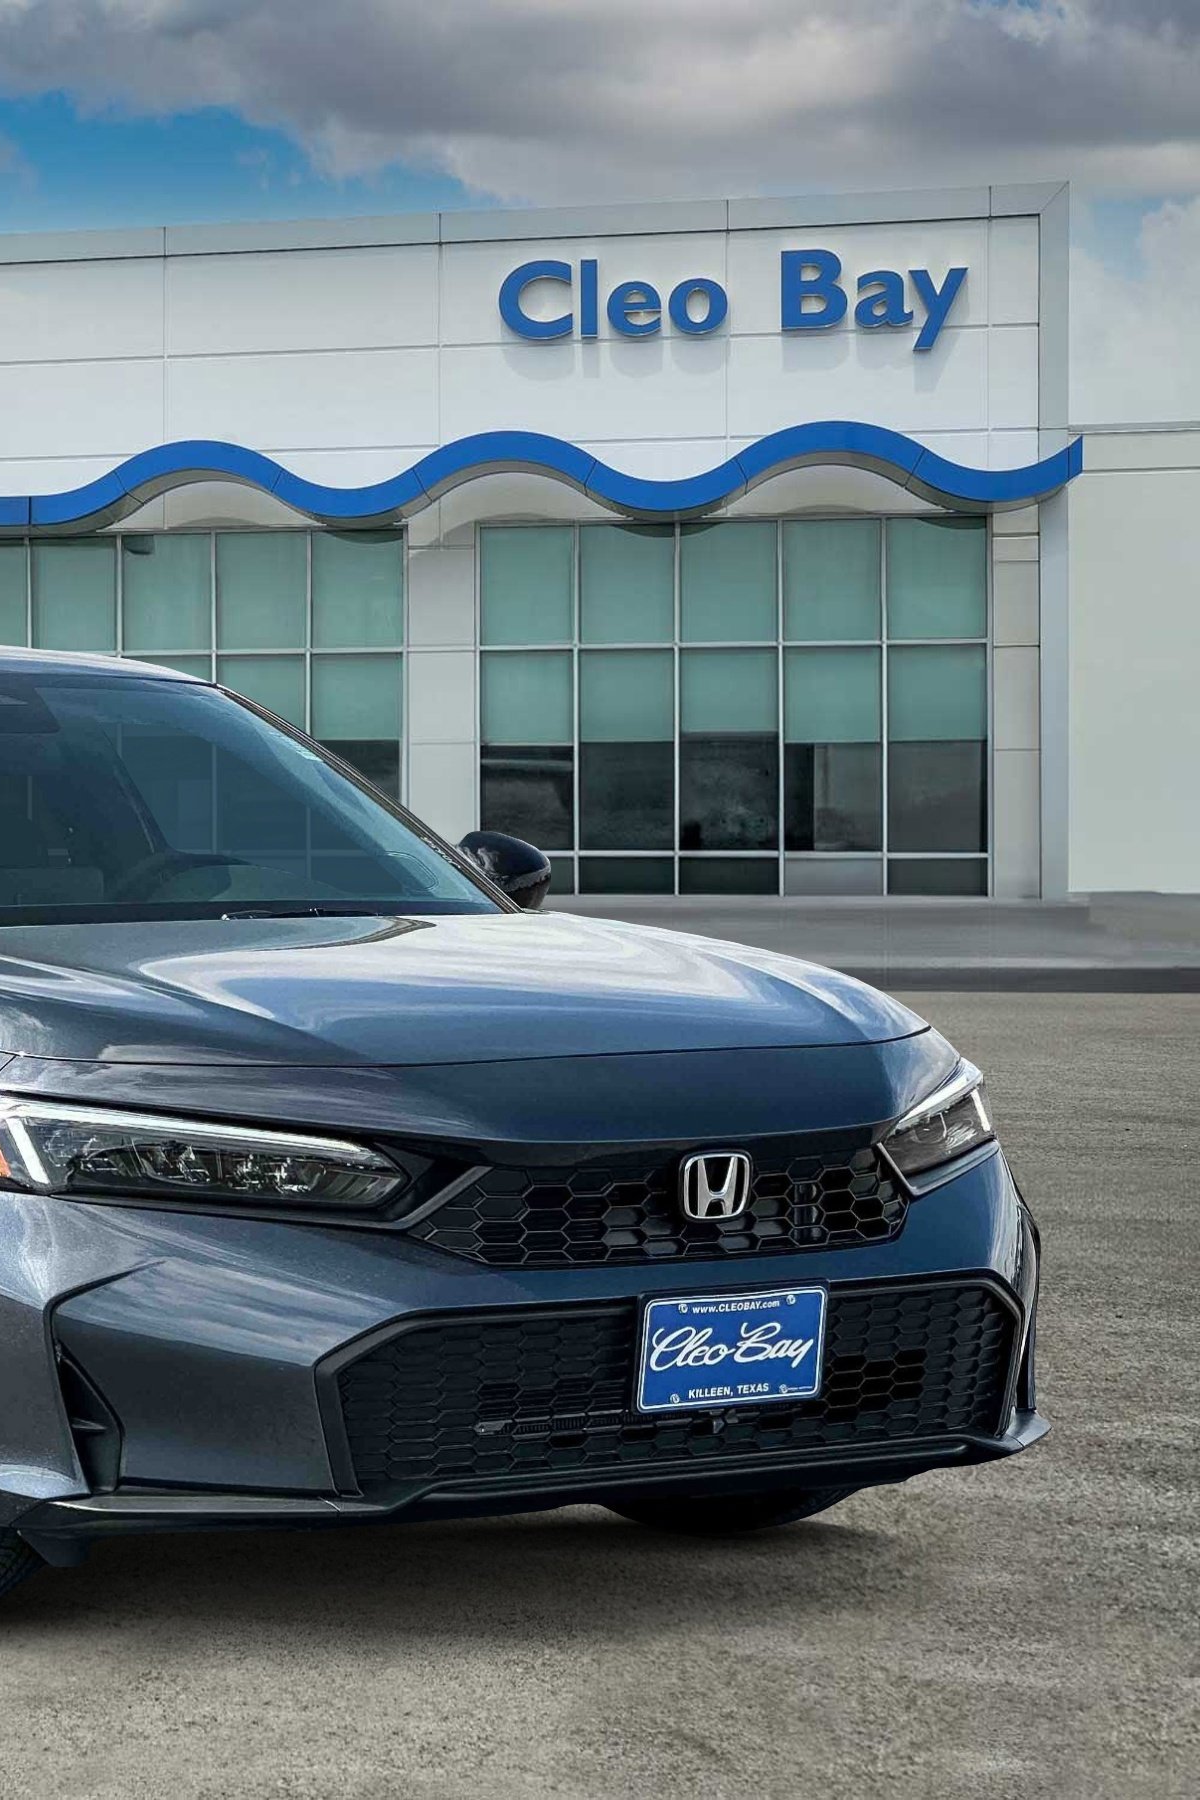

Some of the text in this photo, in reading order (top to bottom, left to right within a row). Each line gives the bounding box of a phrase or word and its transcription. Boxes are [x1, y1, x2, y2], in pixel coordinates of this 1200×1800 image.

[498, 248, 969, 352] Cleo Bay
[692, 1300, 780, 1315] www.CLEOBAY.com
[650, 1322, 814, 1372] Cleo Bay
[688, 1382, 770, 1400] KILLEEN, TEXAS
